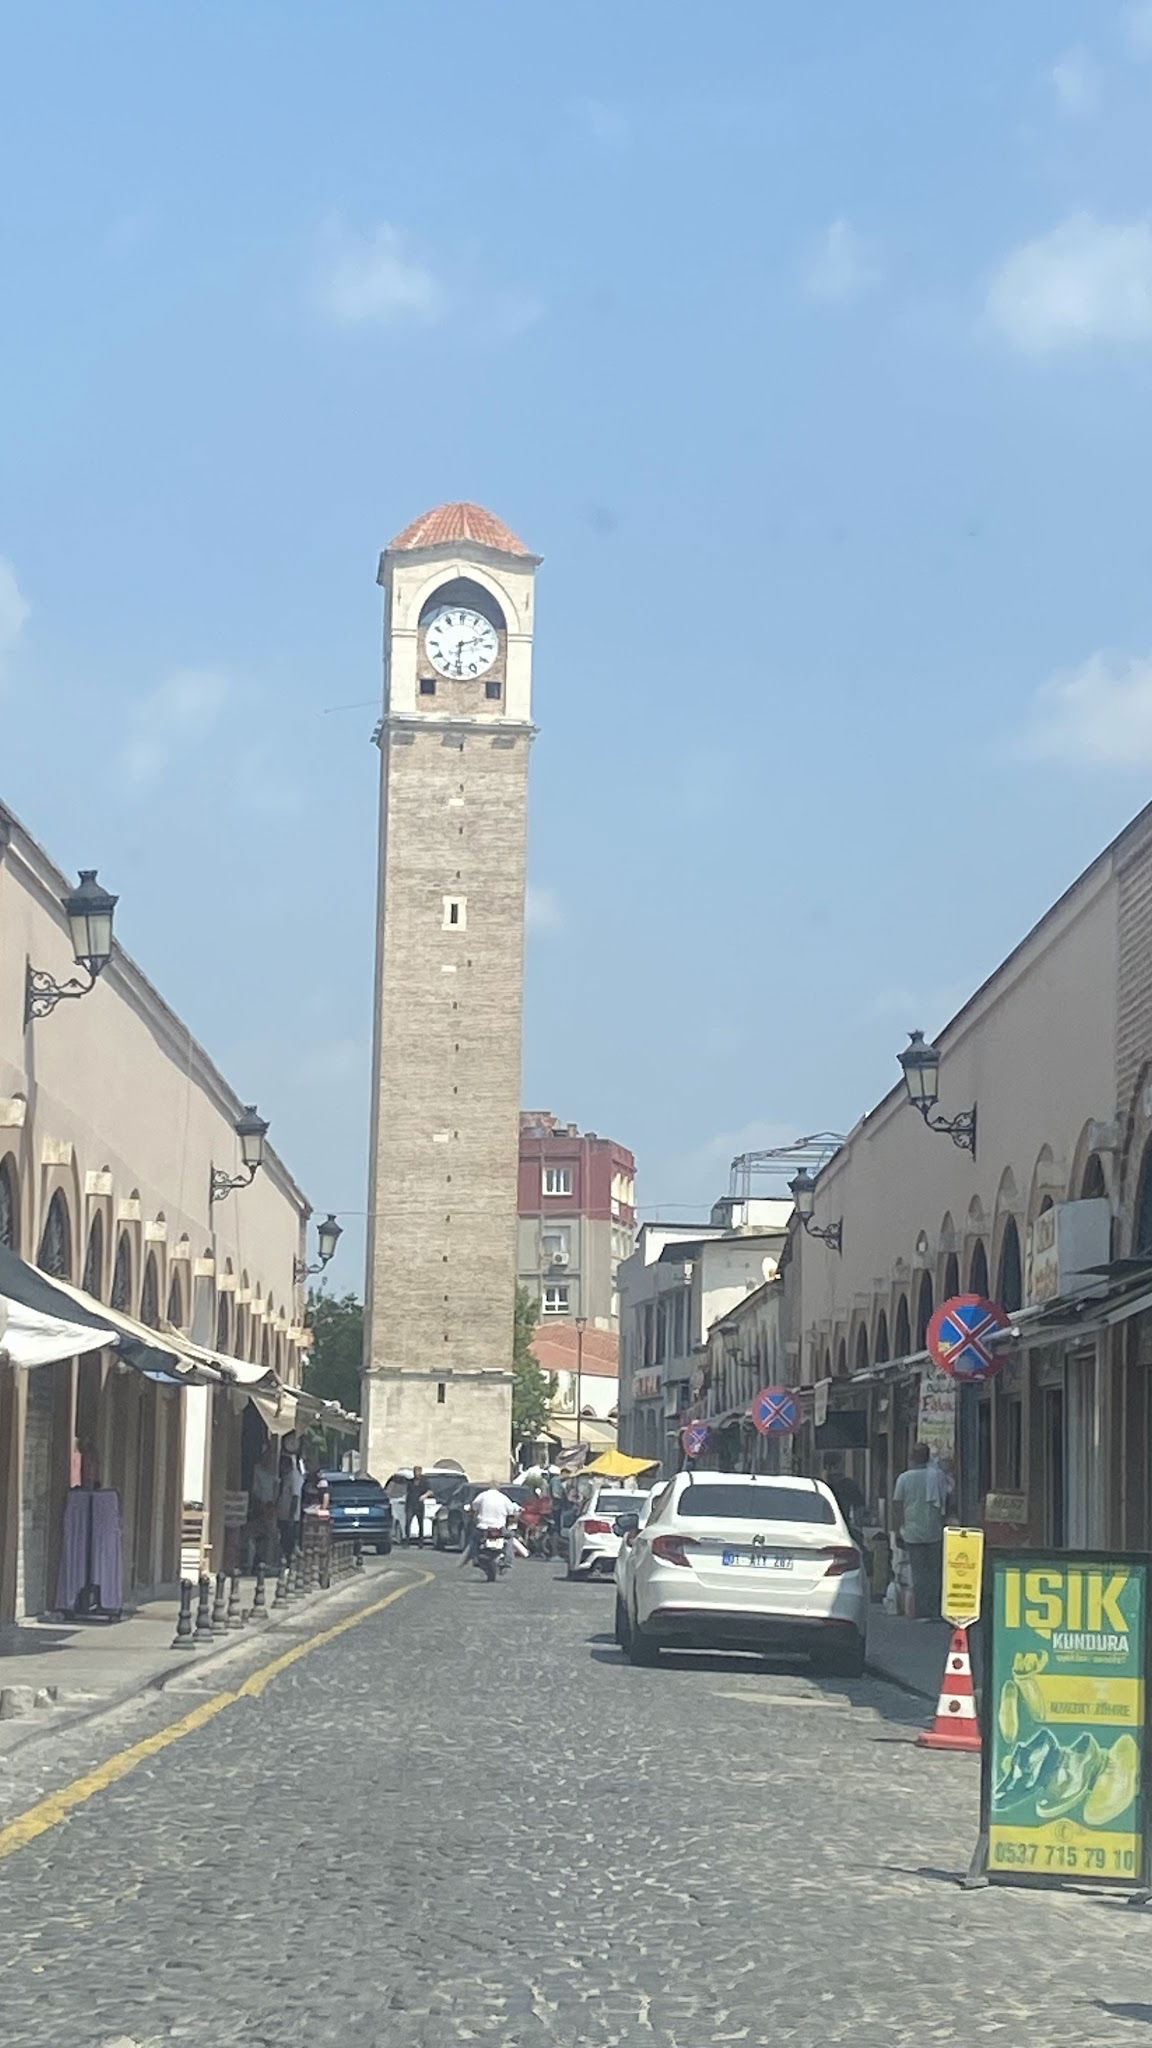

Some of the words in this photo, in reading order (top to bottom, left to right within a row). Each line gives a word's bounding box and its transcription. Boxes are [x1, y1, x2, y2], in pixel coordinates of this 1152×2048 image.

[1005, 1568, 1129, 1639] IŞIK
[1053, 1632, 1129, 1652] KUNDURA
[995, 1842, 1038, 1865] 0537
[1044, 1845, 1077, 1867] 715
[1084, 1847, 1106, 1868] 79
[1113, 1850, 1133, 1871] 10
